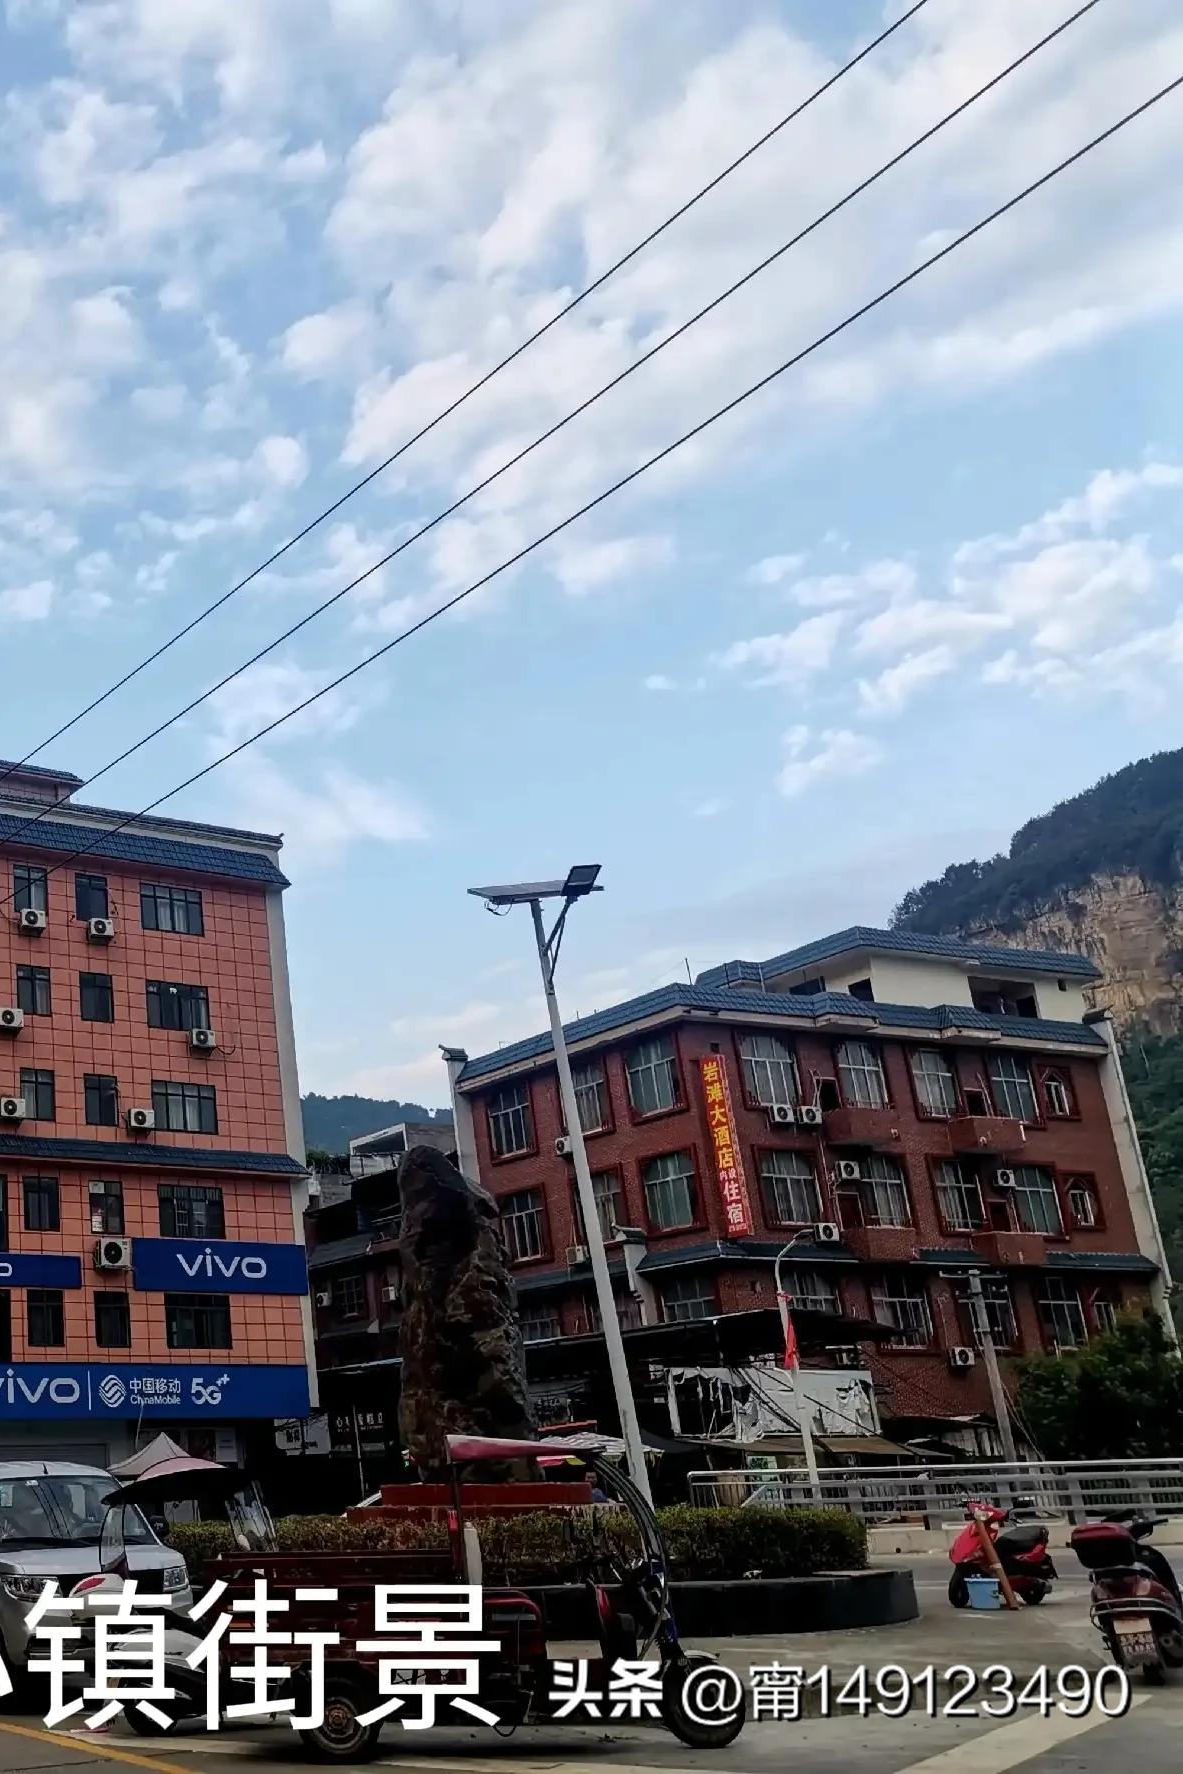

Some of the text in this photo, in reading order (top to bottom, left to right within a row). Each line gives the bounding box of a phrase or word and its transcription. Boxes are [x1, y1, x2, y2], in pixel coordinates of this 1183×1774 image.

[703, 1061, 734, 1169] 岩滩大酒店
[722, 1180, 743, 1224] 住宿
[177, 1248, 267, 1279] vivo
[129, 1377, 181, 1394] 中国移动
